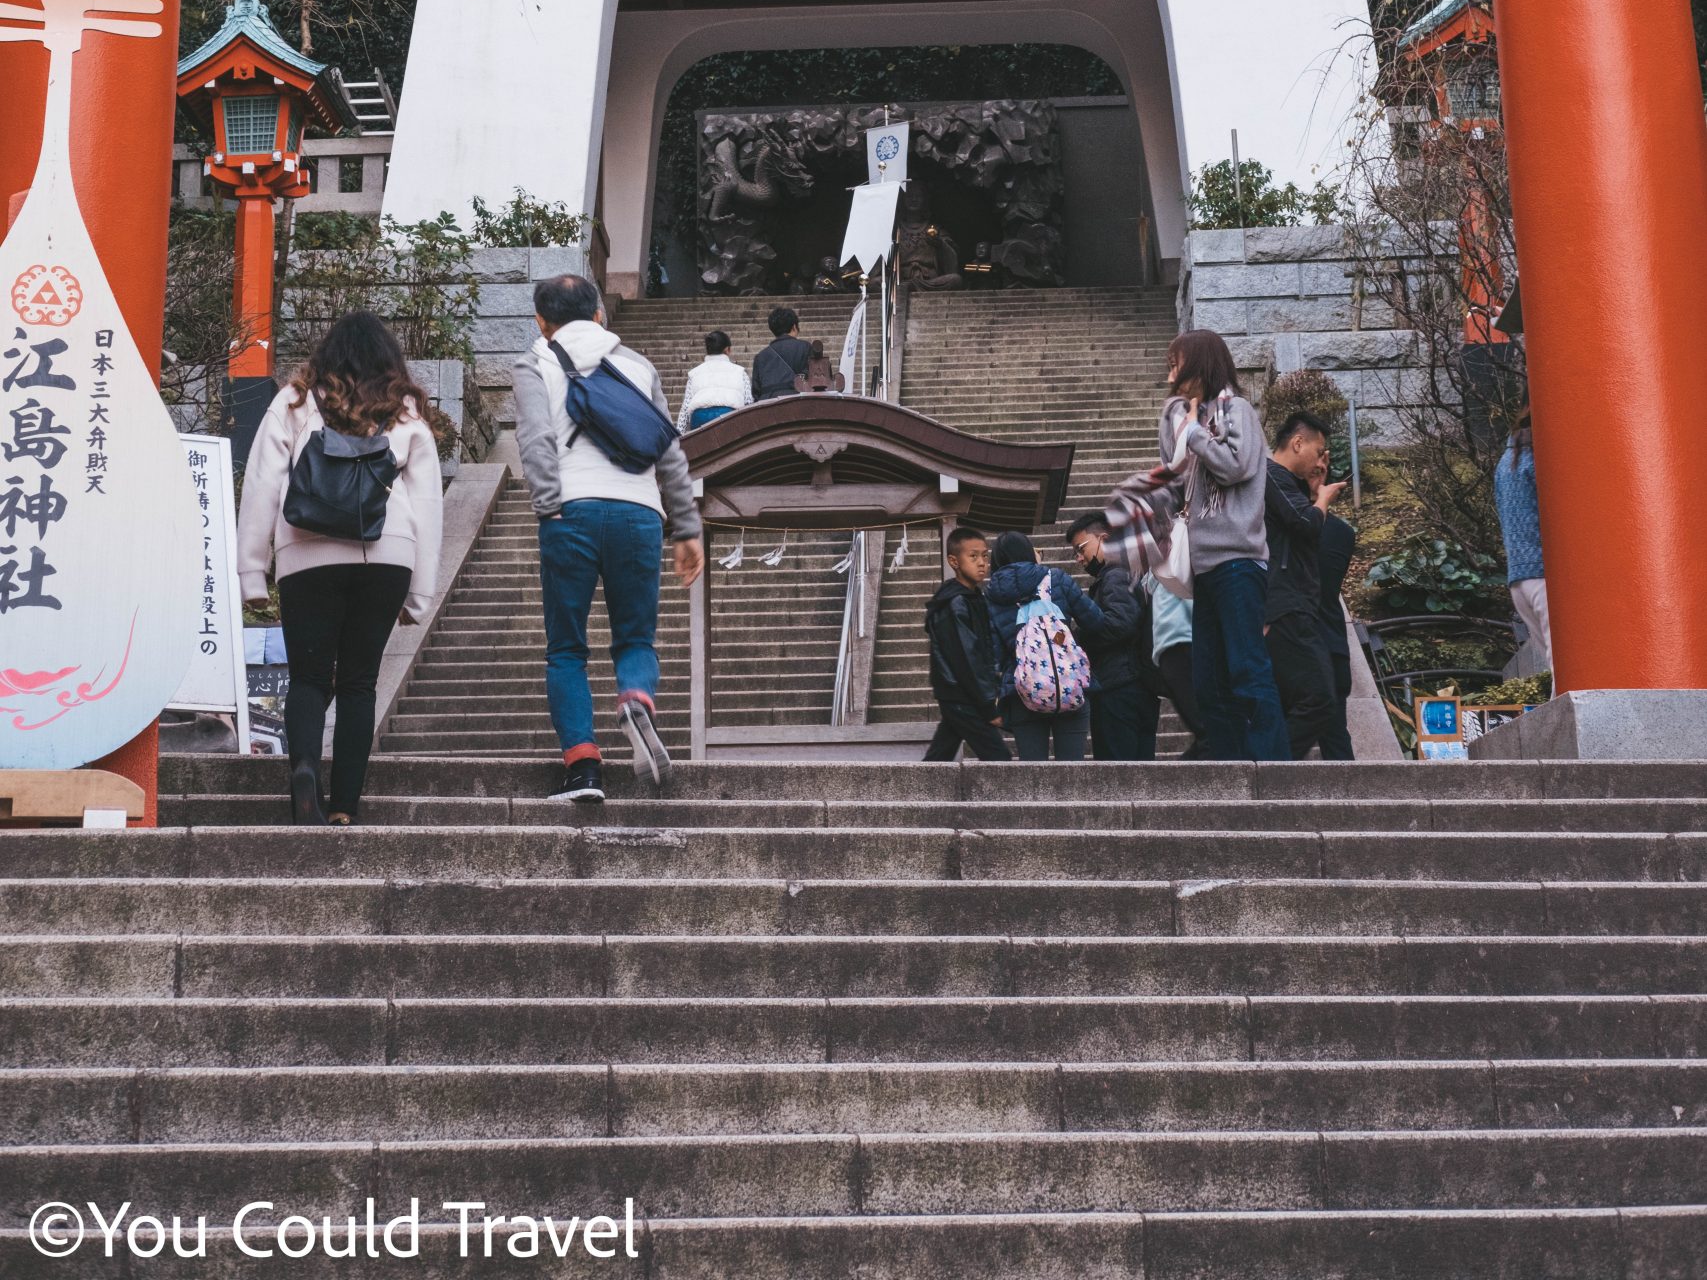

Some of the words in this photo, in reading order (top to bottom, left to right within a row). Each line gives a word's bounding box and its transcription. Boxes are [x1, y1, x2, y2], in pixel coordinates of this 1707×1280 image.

[0, 326, 77, 614] 江島神社
[85, 329, 116, 496] 日本三大弁財天
